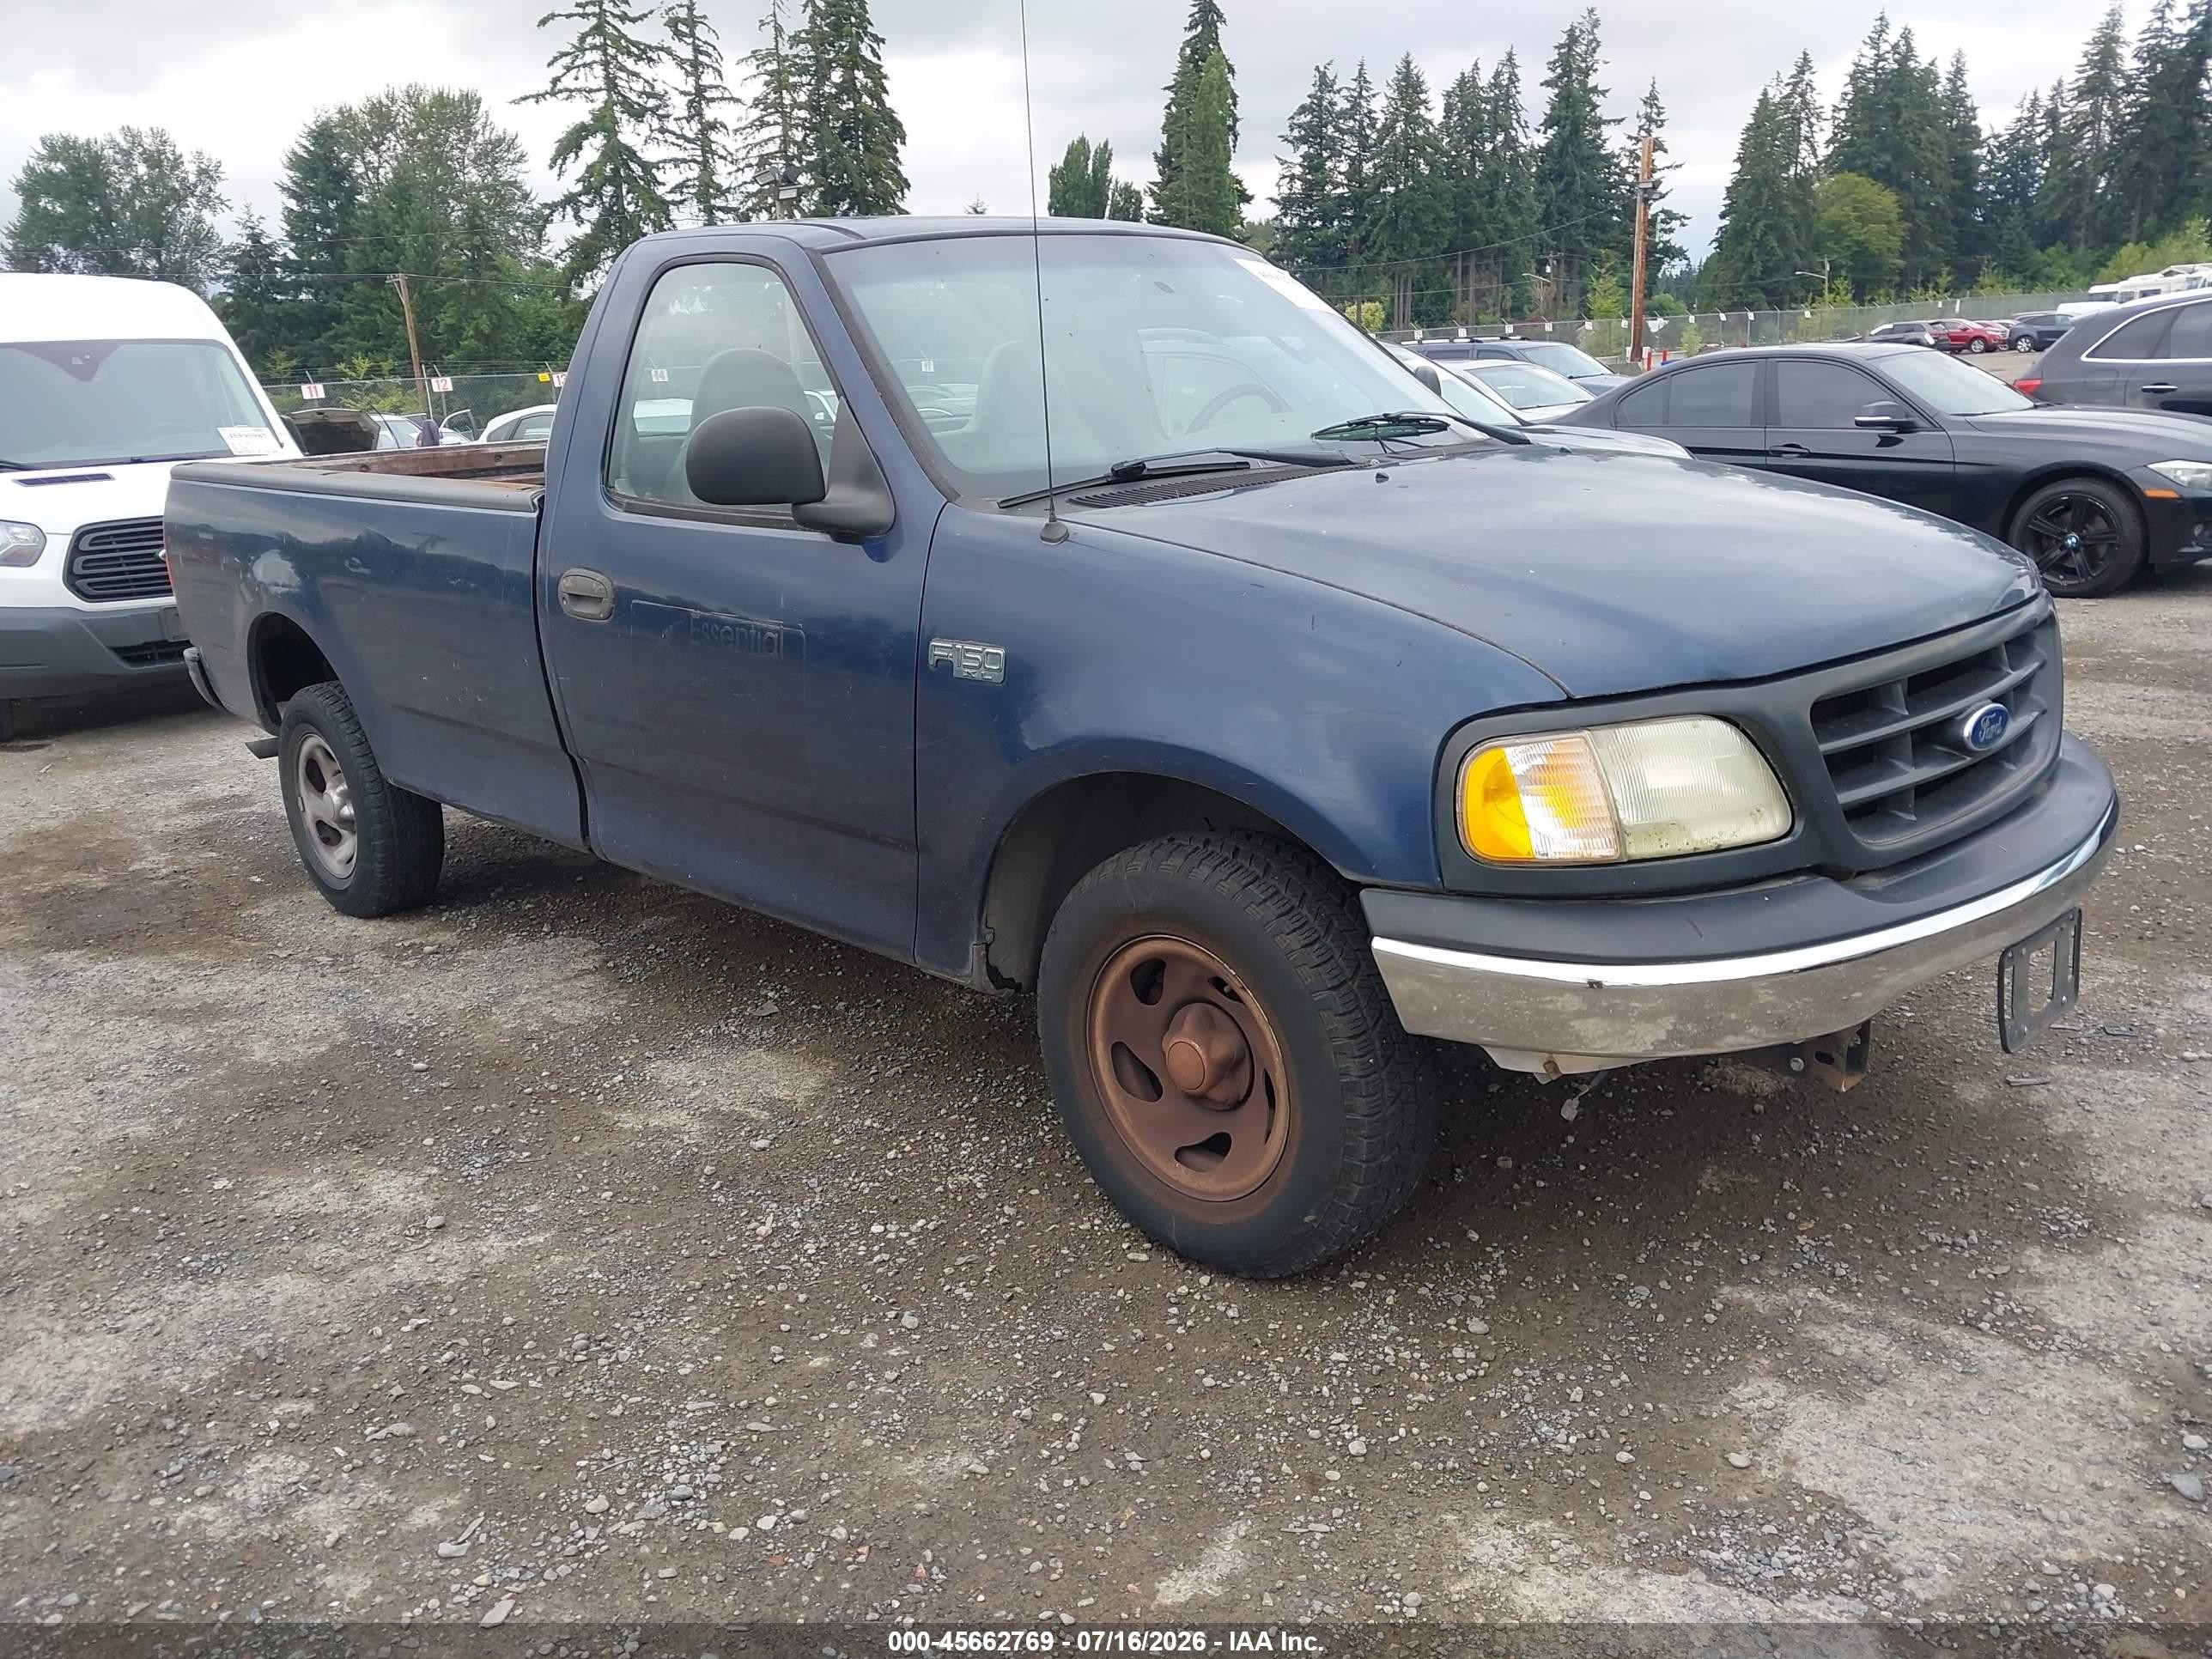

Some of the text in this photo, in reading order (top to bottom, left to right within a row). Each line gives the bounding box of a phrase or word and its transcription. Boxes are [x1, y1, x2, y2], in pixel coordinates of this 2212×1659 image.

[434, 379, 449, 391] 12
[307, 386, 319, 398] 11
[690, 611, 783, 659] Essential
[963, 669, 993, 680] XL
